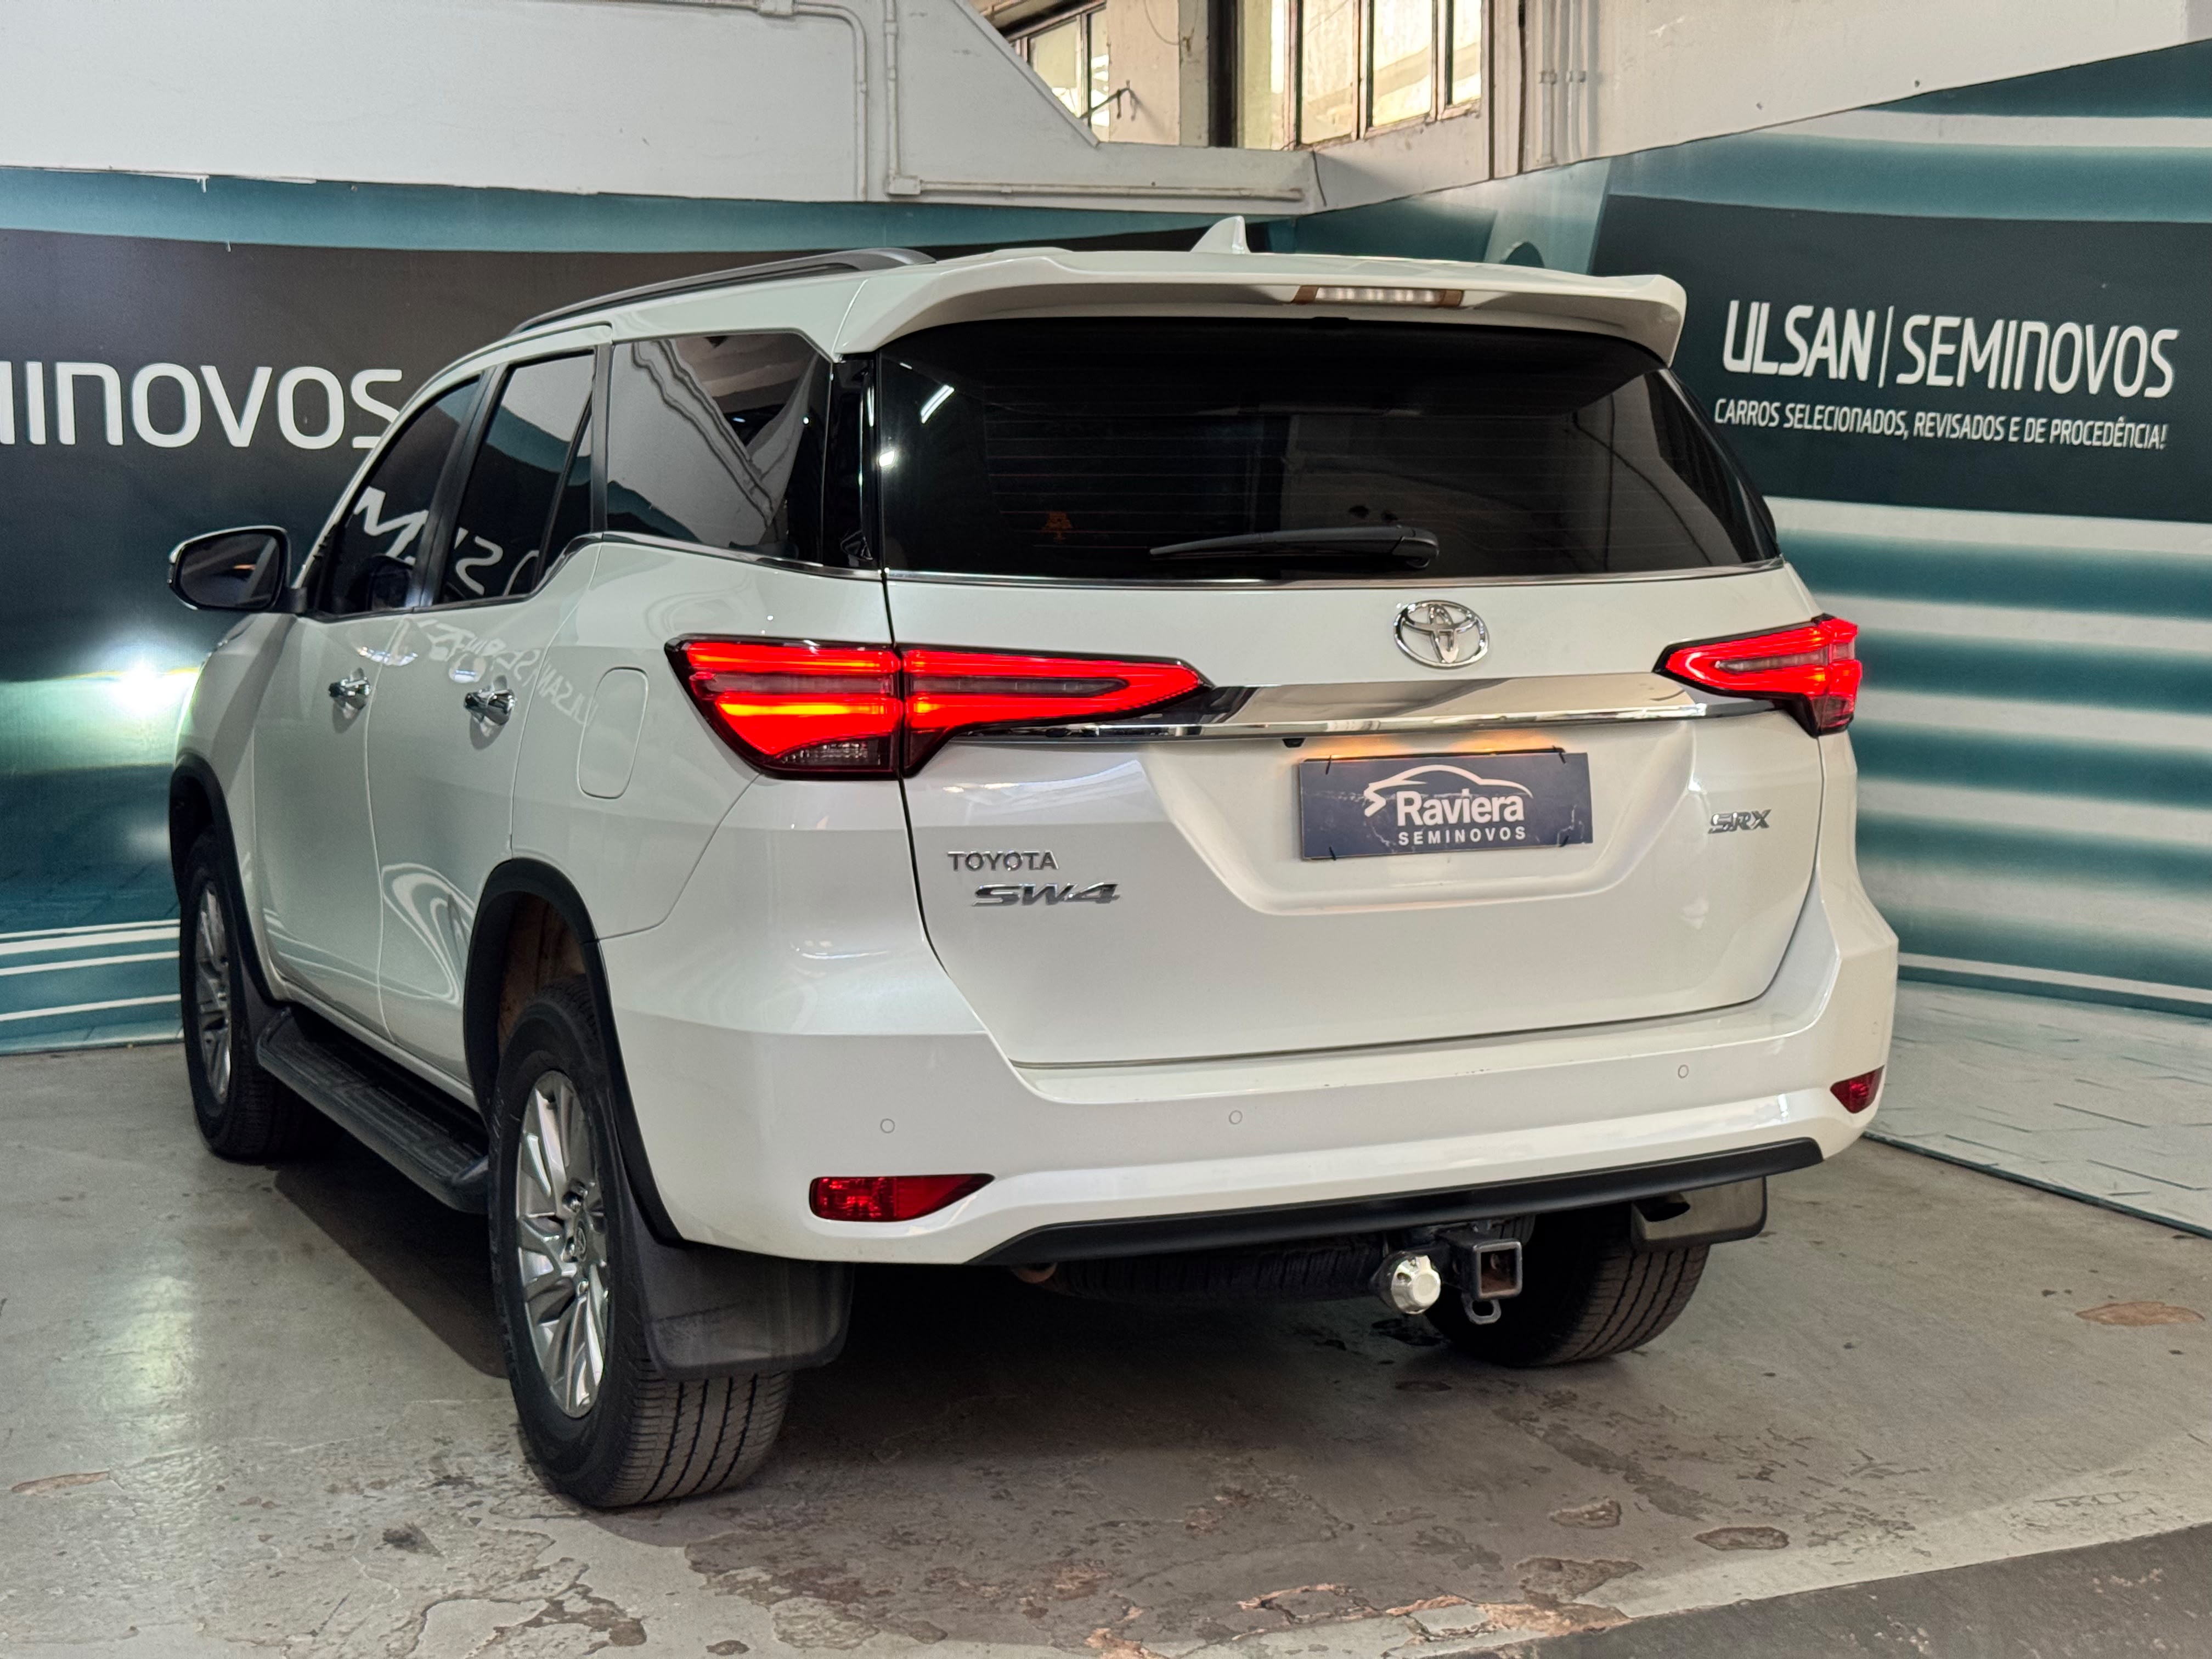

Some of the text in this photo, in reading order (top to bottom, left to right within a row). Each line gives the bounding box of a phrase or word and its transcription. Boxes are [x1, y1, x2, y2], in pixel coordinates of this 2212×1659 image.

[1723, 300, 2180, 398] ULSAN SEMINOVOS
[0, 361, 402, 450] INOVOS
[1714, 398, 2169, 450] CARROS SELECIONADOS, REVISADOS E DE PROCEDÊNCIA!
[1396, 788, 1525, 827] Raviera
[1708, 808, 1772, 834] SRX
[1398, 826, 1527, 847] SEMINOVOS
[947, 849, 1059, 872] TOYOTA
[970, 881, 1121, 907] SW4
